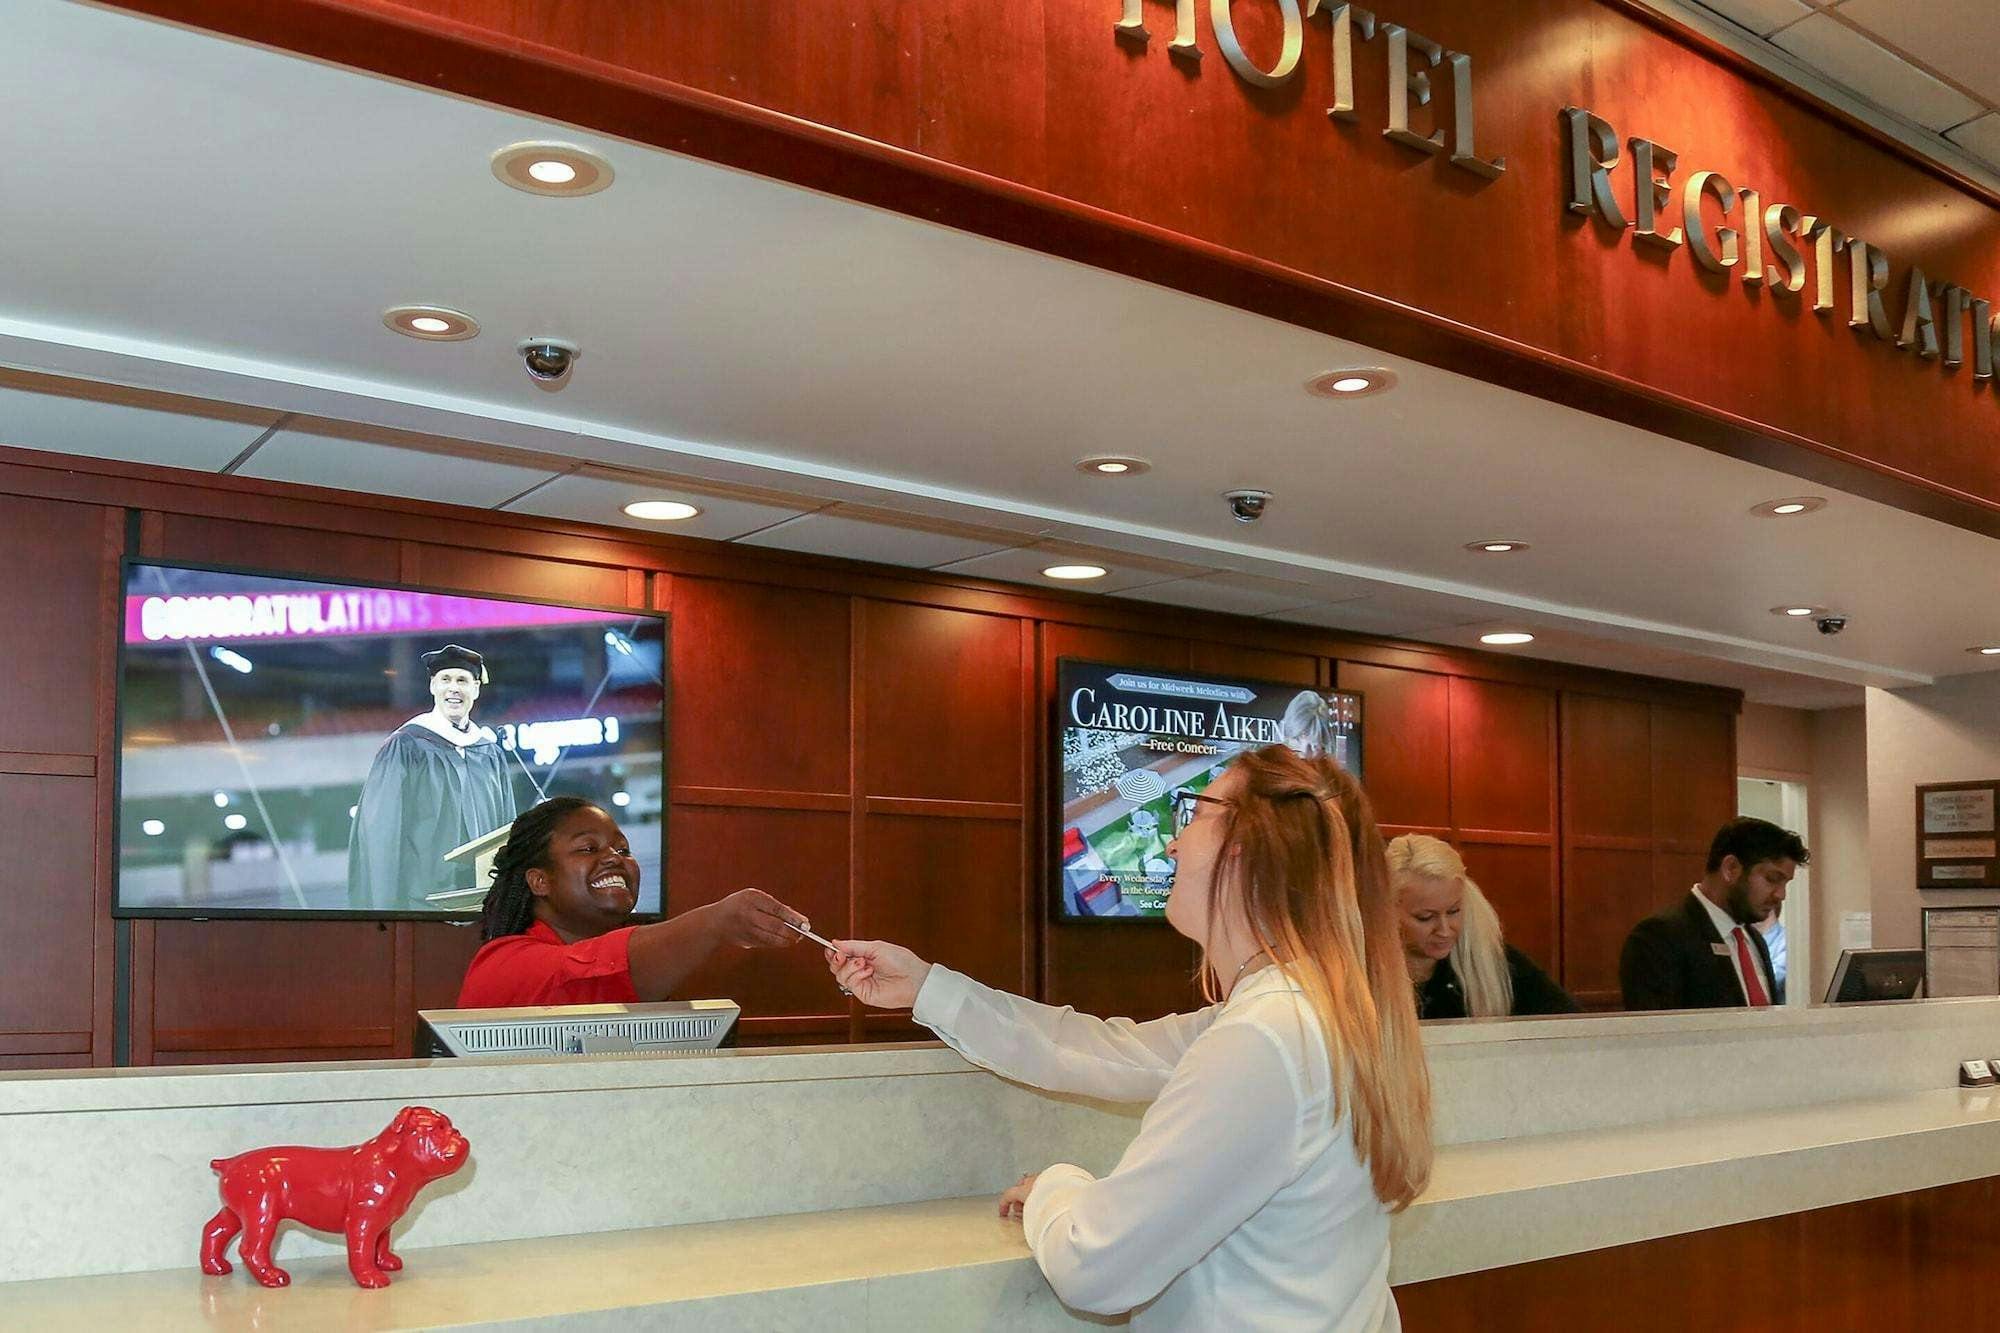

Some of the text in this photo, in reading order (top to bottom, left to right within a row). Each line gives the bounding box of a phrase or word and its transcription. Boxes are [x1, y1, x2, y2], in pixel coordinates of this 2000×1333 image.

[1562, 106, 2000, 381] REGISTRATI
[1119, 678, 1136, 688] Join
[1148, 681, 1160, 690] for
[1161, 683, 1194, 694] Midweek
[1195, 687, 1229, 698] Melodies
[1230, 690, 1247, 700] with
[1071, 688, 1286, 743] CAROLINE AIKEN
[1150, 738, 1218, 755] Free Concert
[1099, 874, 1120, 884] Every
[1124, 874, 1166, 884] Wednesday
[1121, 886, 1172, 897] in the Georgi
[1139, 900, 1152, 908] See
